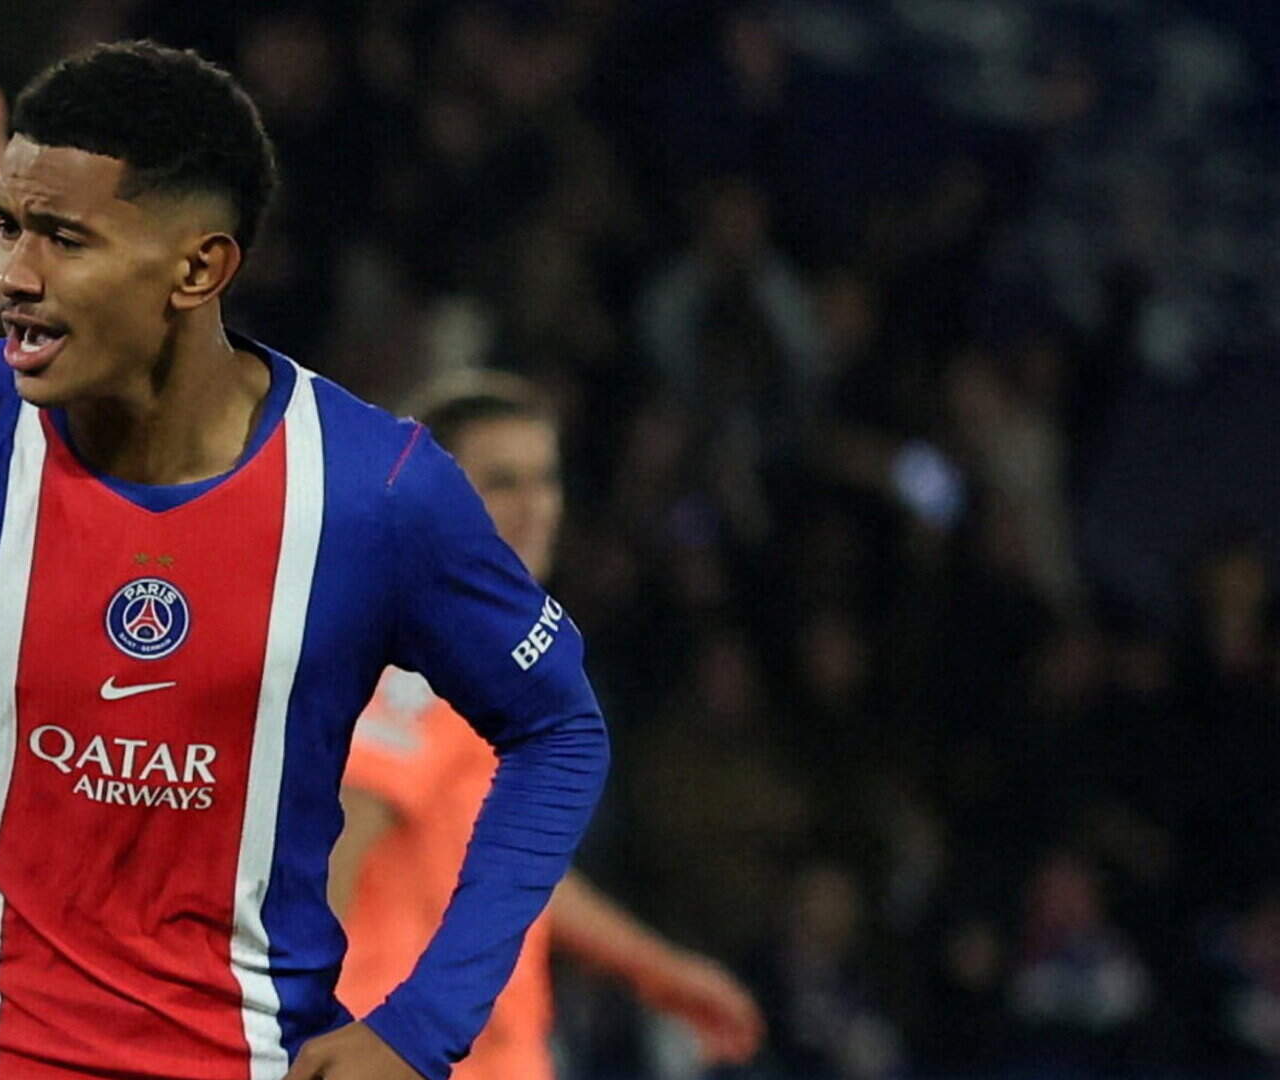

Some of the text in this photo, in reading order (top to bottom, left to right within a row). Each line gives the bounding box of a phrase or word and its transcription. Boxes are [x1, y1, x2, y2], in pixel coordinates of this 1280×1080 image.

[123, 583, 177, 604] PARIS
[28, 724, 216, 783] QATAR
[73, 774, 212, 809] AIRWAYS
